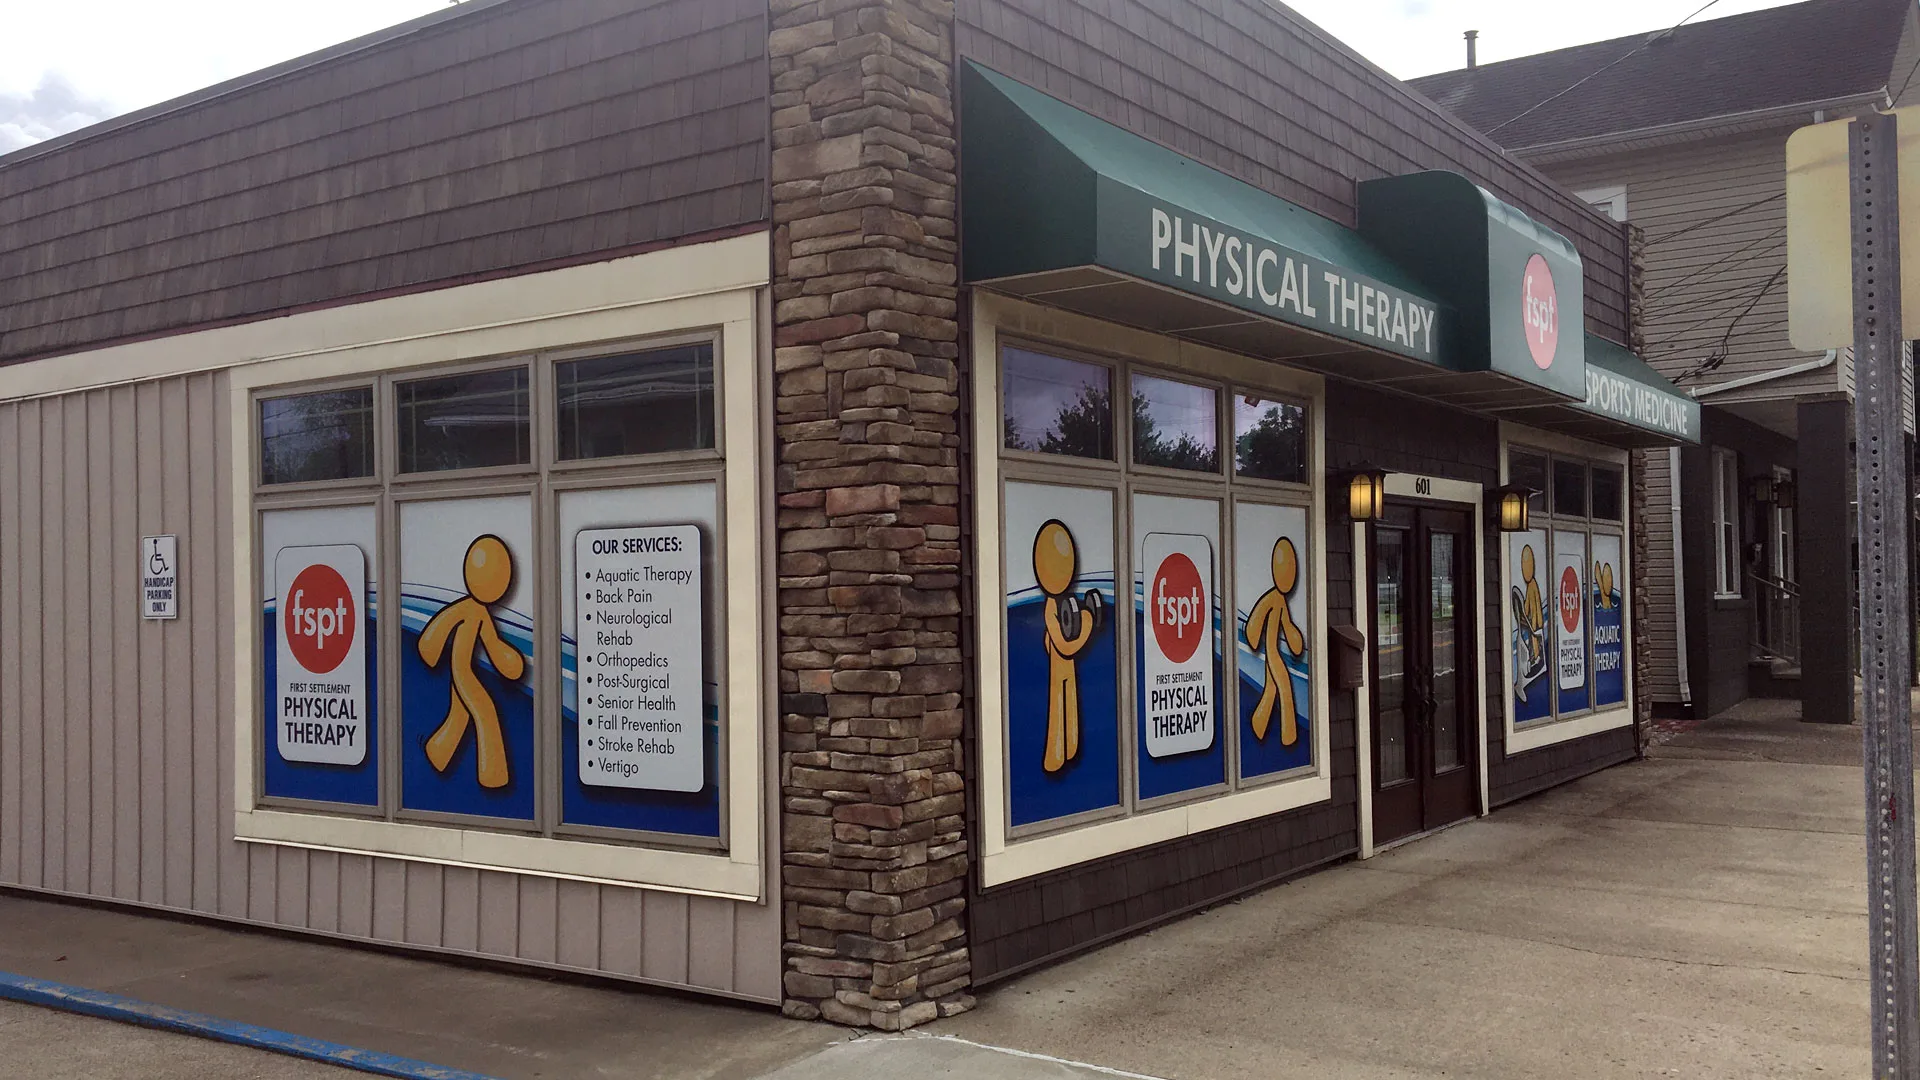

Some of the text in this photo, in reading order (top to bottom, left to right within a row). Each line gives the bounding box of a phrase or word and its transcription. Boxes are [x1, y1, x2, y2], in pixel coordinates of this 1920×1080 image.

[1152, 207, 1435, 354] PHYSICAL THERAPY
[1526, 275, 1554, 344] fspt
[1585, 368, 1688, 435] SPORTS MEDICINE
[1415, 477, 1431, 495] 601
[592, 536, 682, 555] OUR SERVICES:
[144, 577, 174, 587] HANDICAP
[595, 566, 693, 586] Aquatic Therapy
[147, 589, 172, 600] PARKING
[596, 587, 652, 603] Back Pain
[1562, 581, 1578, 618] fspt
[152, 601, 167, 612] ONLY
[1157, 577, 1199, 639] fspt
[292, 589, 347, 649] fspt
[596, 608, 672, 628] Neurological
[597, 631, 633, 646] Rehab
[1594, 625, 1621, 645] AQUATIC
[596, 651, 668, 670] Orthopedics
[1560, 647, 1583, 662] PHYSICAL
[1594, 651, 1621, 672] THERAPY
[1156, 671, 1203, 685] FIRST SETTLEMENT
[1561, 663, 1583, 678] THERAPY
[289, 682, 351, 694] FIRST SETTLEMENT
[597, 673, 670, 693] Post-Surgical
[284, 696, 357, 720] PHYSICAL
[597, 694, 676, 711] Senior Health
[1151, 685, 1208, 712] PHYSICAL
[598, 714, 682, 733] Fall Prevention
[1152, 710, 1207, 739] THERAPY
[285, 722, 356, 747] THERAPY
[598, 736, 675, 755] Stroke Rehab
[598, 756, 639, 778] Vertigo
